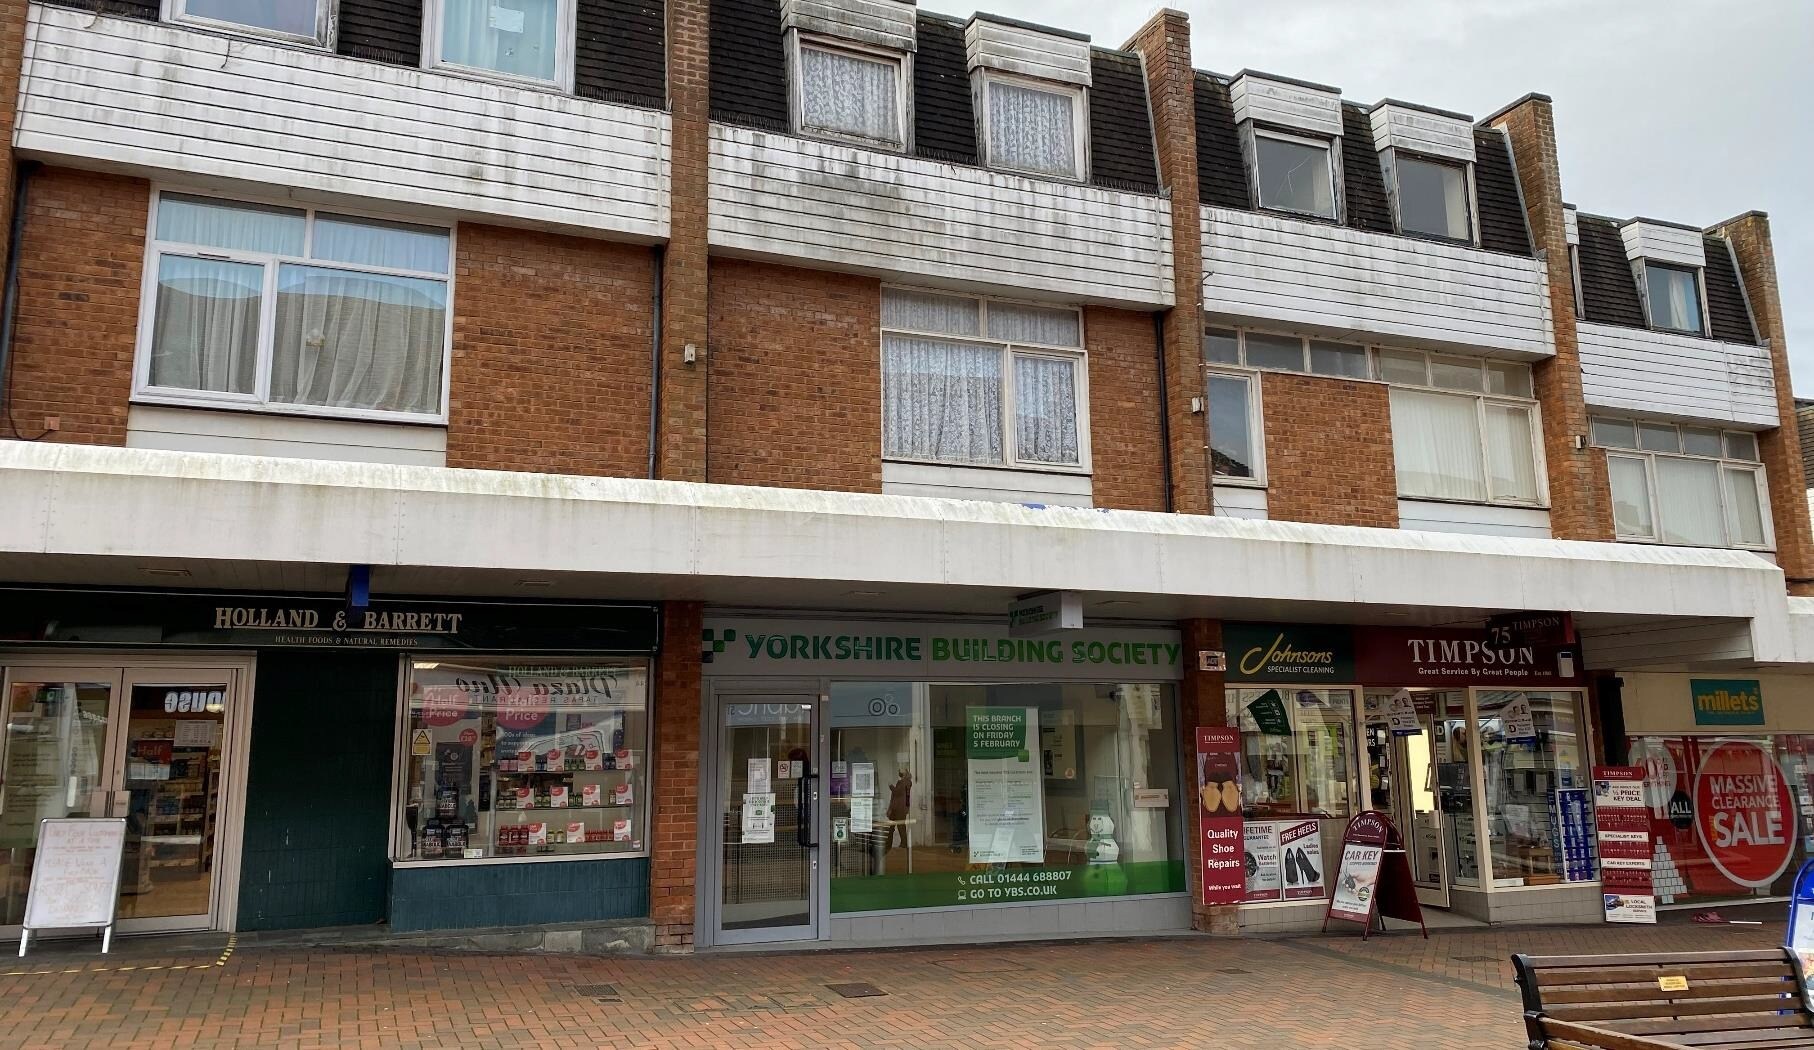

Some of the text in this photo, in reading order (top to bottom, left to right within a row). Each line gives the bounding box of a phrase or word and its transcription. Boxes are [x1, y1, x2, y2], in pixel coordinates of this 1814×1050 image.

[213, 607, 463, 634] HOLLAND & BARRETT
[275, 635, 305, 643] HEALTH
[308, 636, 333, 644] FOODS
[343, 637, 377, 645] NATURAL
[380, 638, 418, 646] REMEDIES
[1491, 626, 1511, 644] 75
[744, 634, 921, 661] YORKSHIRE
[932, 638, 1181, 665] BUILDING SOCIETY
[1239, 632, 1333, 675] Johnsons
[1408, 639, 1534, 665] TIMPSON
[1267, 665, 1335, 674] SPECIALIST CLEANING
[1418, 667, 1529, 677] Great Service By Great People
[1697, 690, 1759, 711] millets
[505, 708, 538, 721] Price
[973, 723, 1014, 731] IS CLOSING
[973, 731, 1014, 739] ON FRIDAY
[973, 740, 1020, 748] 5 FEBRUARY
[1710, 775, 1777, 794] MASSIVE
[1670, 801, 1692, 814] ALL
[1712, 795, 1780, 810] CLEARANCE
[1243, 825, 1272, 834] IFETIME
[1352, 818, 1384, 833] TIMPSON
[1714, 811, 1785, 848] SALE
[1207, 829, 1239, 840] Quality
[1281, 823, 1317, 843] FREE HEELS
[1212, 844, 1235, 853] Shoe
[1257, 853, 1277, 861] Watch
[1344, 850, 1380, 861] CAR KEY
[1207, 859, 1240, 871] Repairs
[969, 870, 1072, 885] CALL 01444 688807
[970, 885, 1057, 899] GO TO YBS.CO.UK
